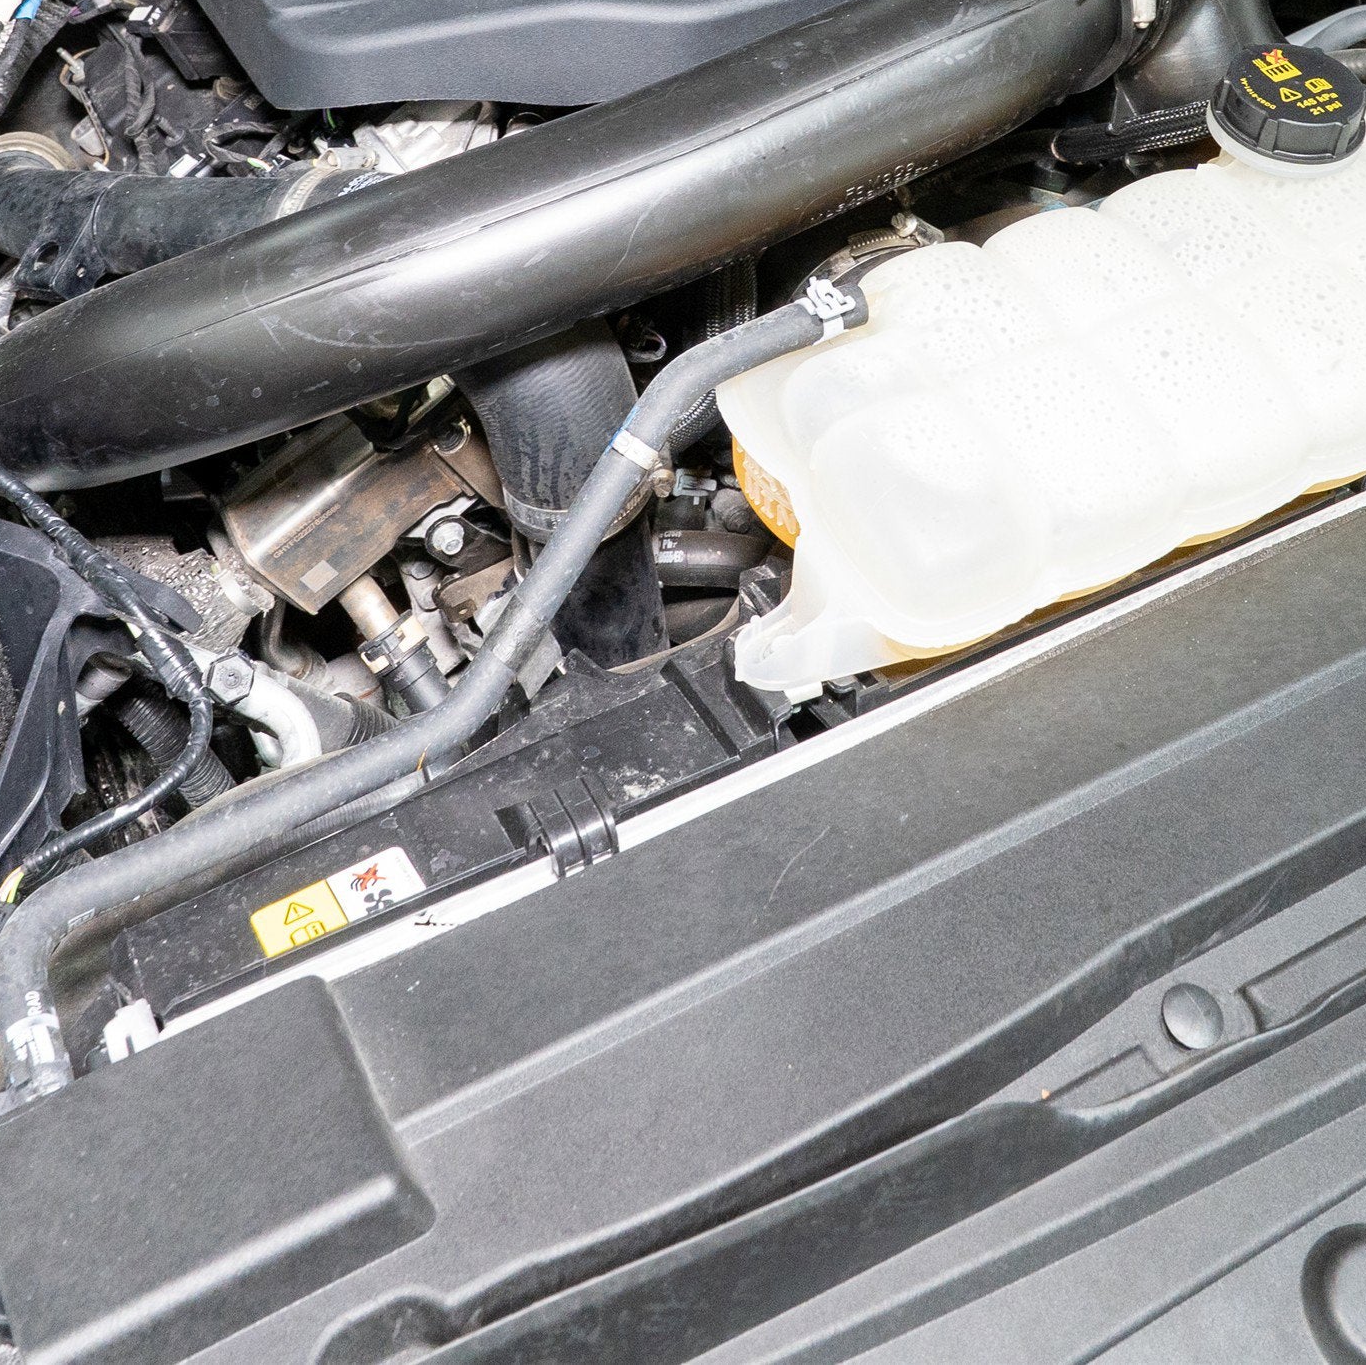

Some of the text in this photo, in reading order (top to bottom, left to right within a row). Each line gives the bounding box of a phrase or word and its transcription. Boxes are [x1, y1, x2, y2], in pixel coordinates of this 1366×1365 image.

[1296, 91, 1339, 109] 145 kPa
[1309, 106, 1326, 116] 21
